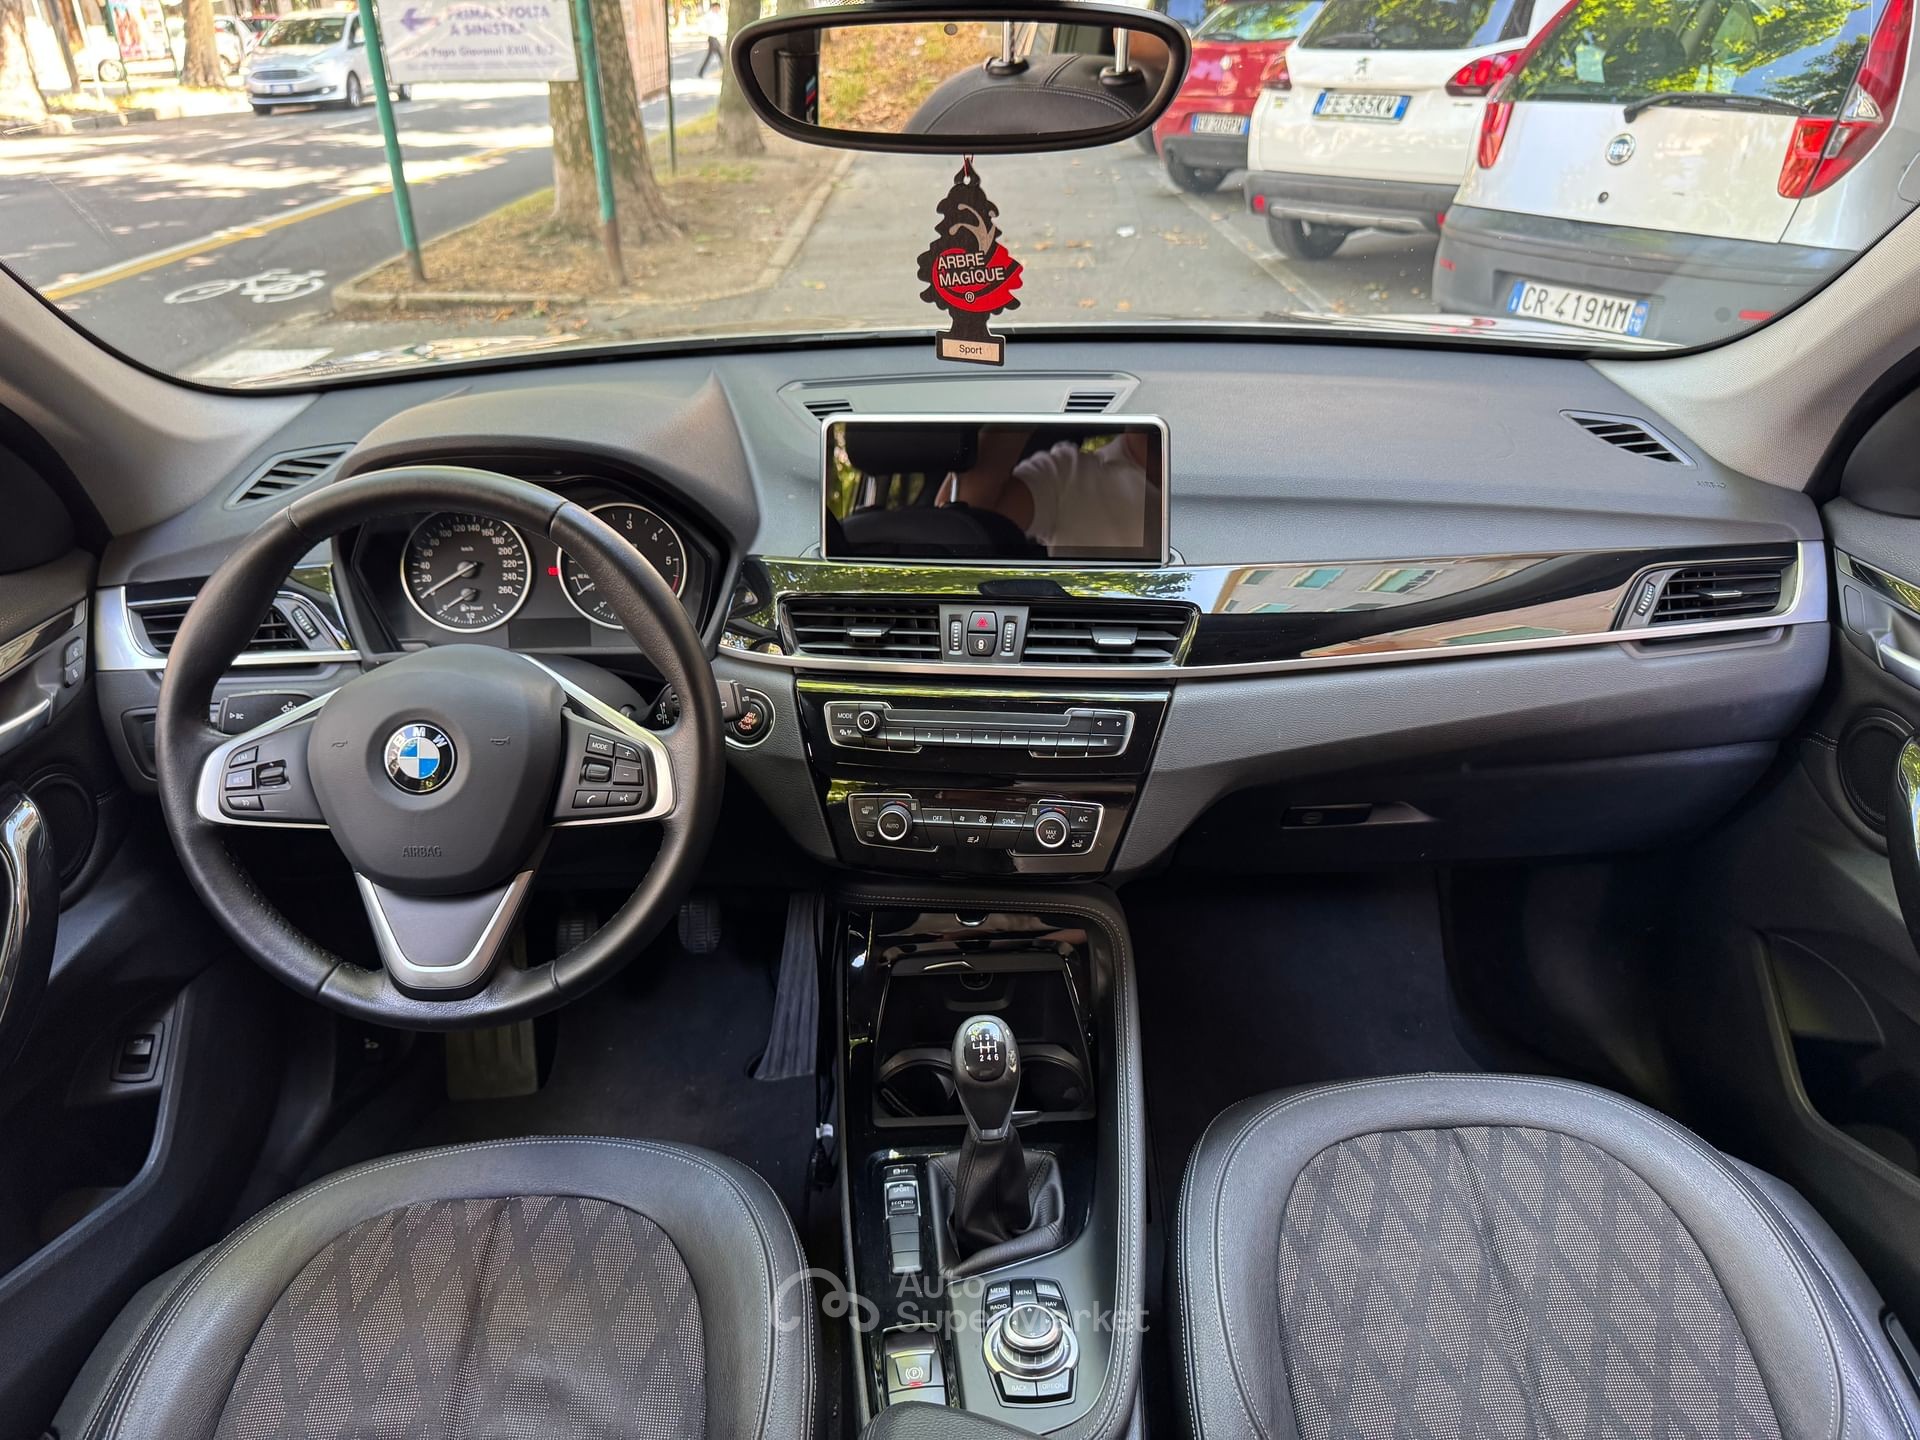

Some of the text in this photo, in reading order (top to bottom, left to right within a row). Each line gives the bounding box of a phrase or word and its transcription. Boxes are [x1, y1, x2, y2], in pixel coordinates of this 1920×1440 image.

[938, 252, 985, 270] ARBRE
[1522, 286, 1548, 314] CR
[1555, 291, 1630, 330] 419MM
[959, 344, 982, 355] Sport
[626, 520, 633, 530] 3
[651, 532, 658, 542] 4
[498, 547, 513, 556] 200
[502, 560, 517, 568] 220
[665, 556, 672, 566] 5
[420, 562, 430, 570] 40
[422, 575, 432, 583] 20
[502, 573, 517, 581] 240
[498, 586, 513, 594] 260
[591, 742, 609, 750] MODE
[402, 846, 441, 858] AIRBAG
